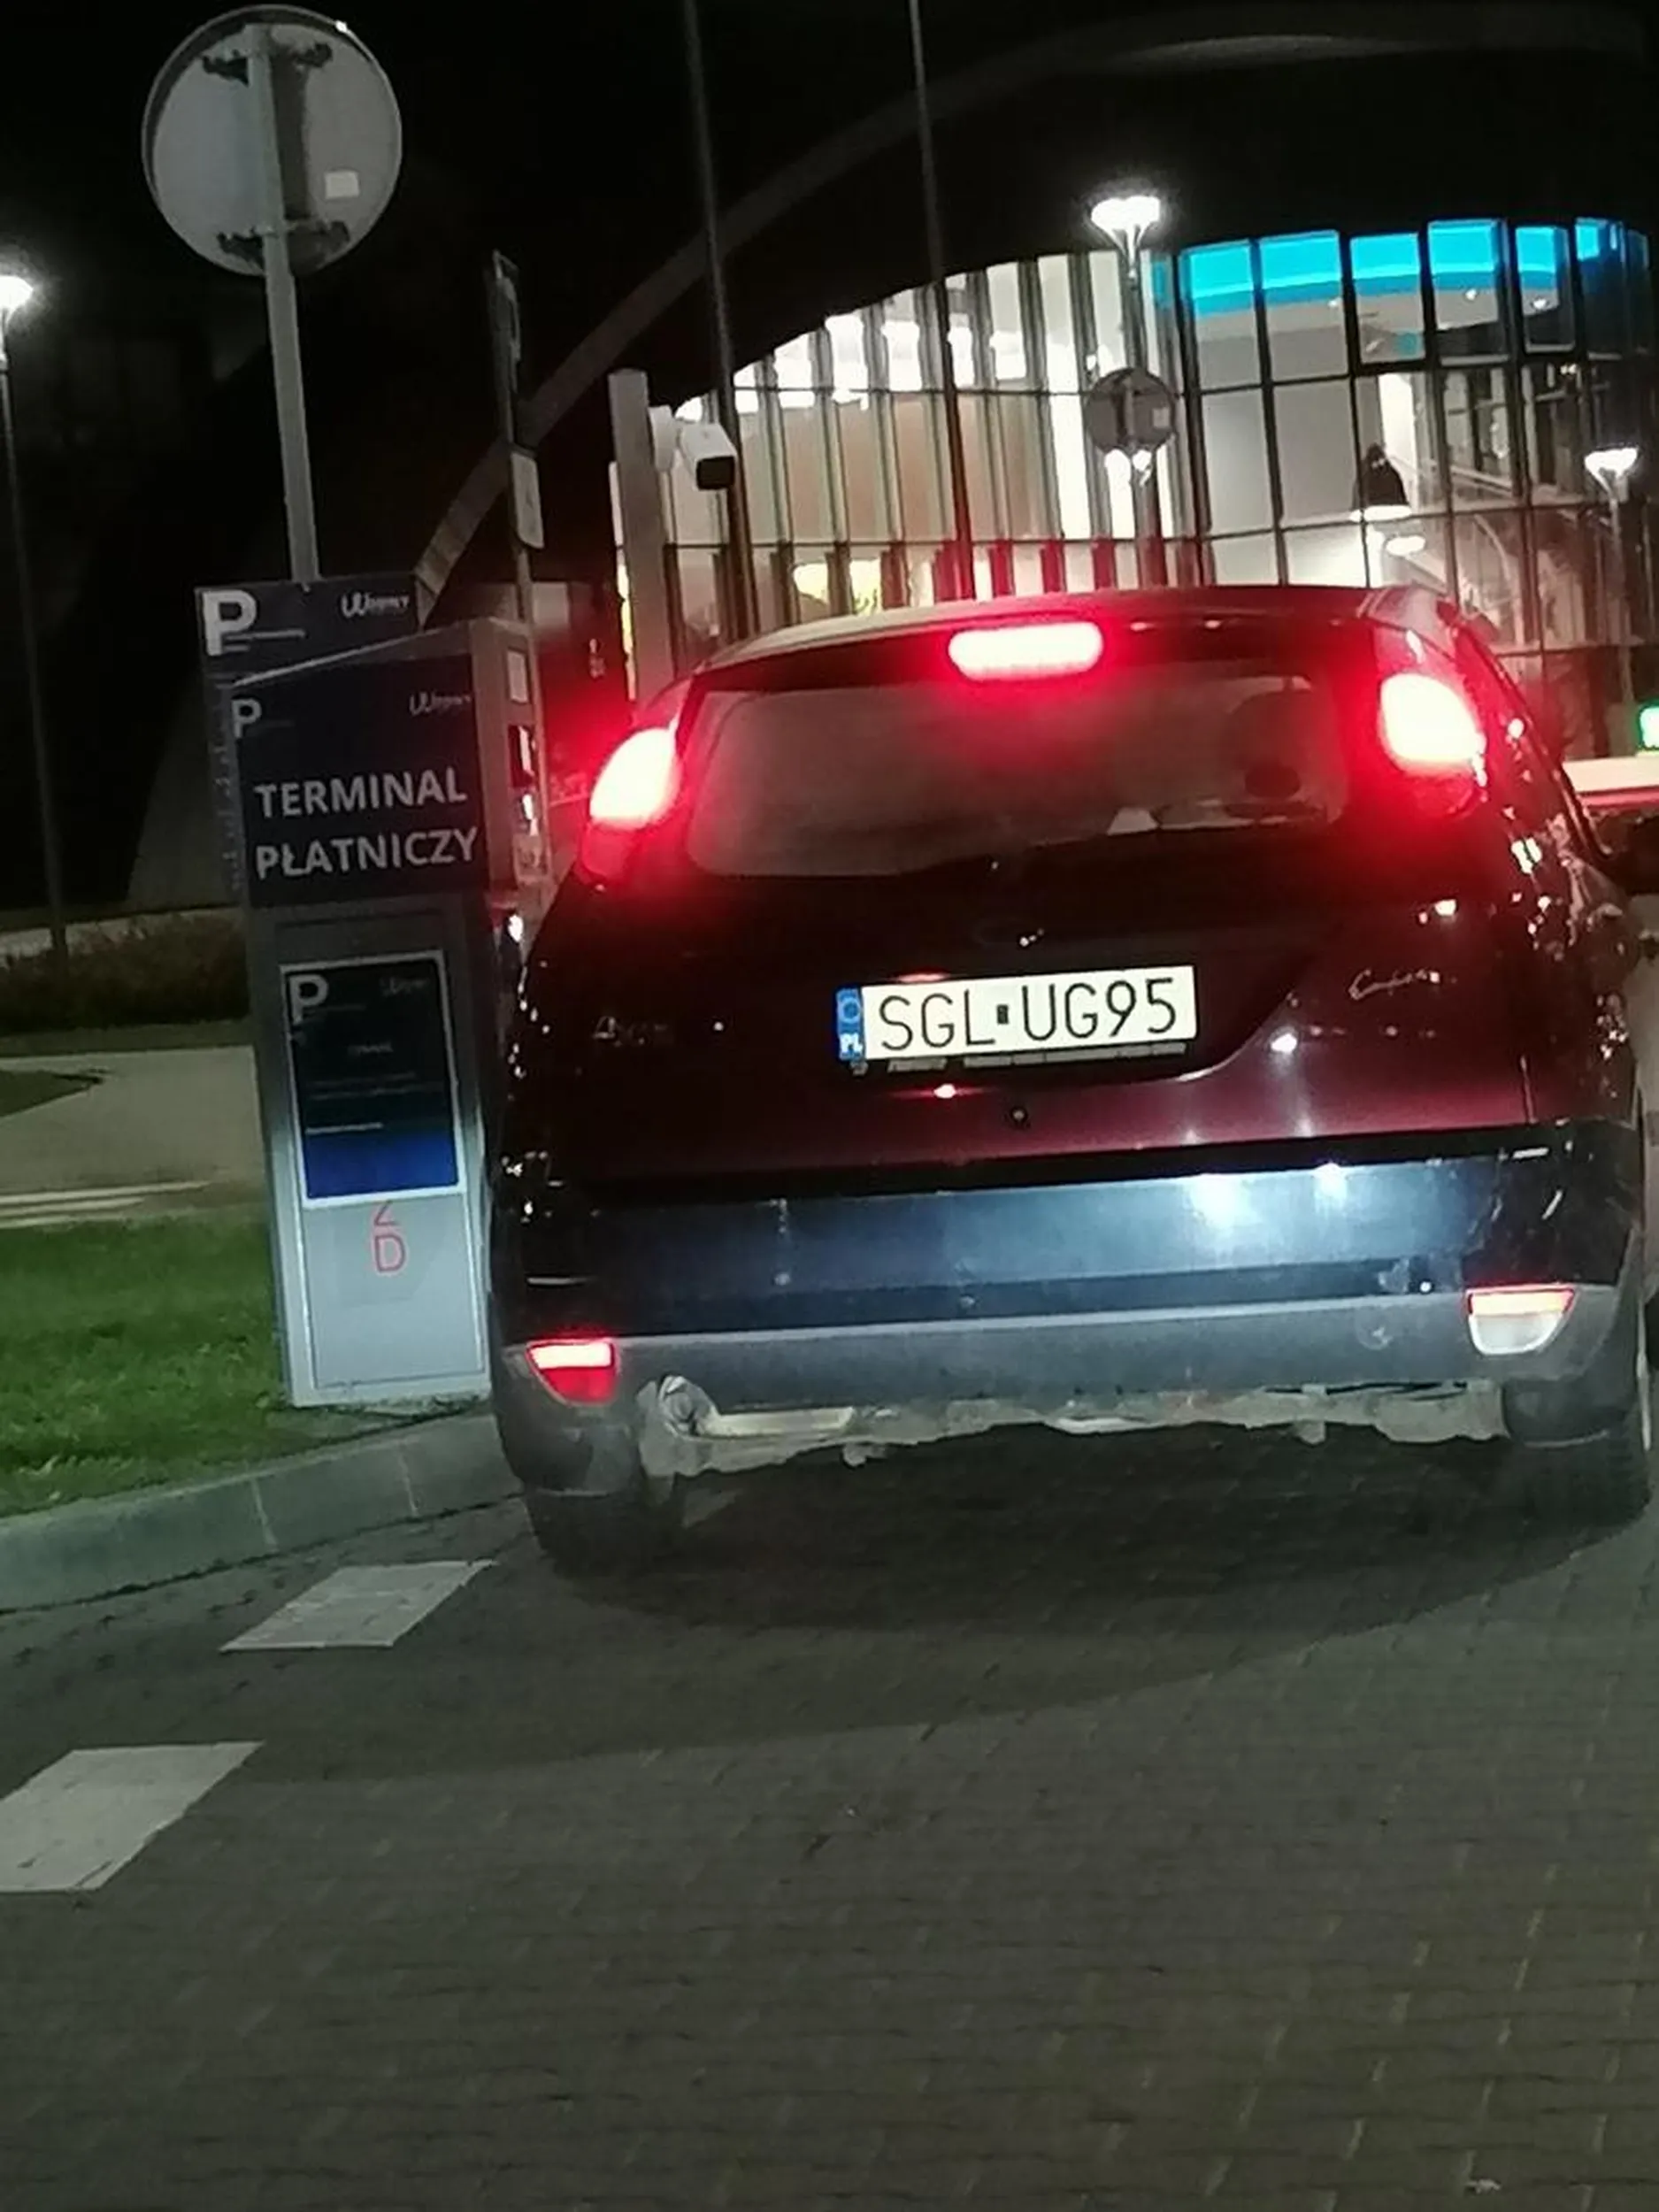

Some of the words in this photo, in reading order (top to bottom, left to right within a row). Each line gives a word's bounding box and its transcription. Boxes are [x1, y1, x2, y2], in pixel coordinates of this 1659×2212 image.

[203, 590, 257, 657] P
[231, 698, 263, 739] P
[254, 766, 467, 818] TERMINAL
[255, 826, 479, 879] PŁATNICZY
[289, 973, 329, 1025] P
